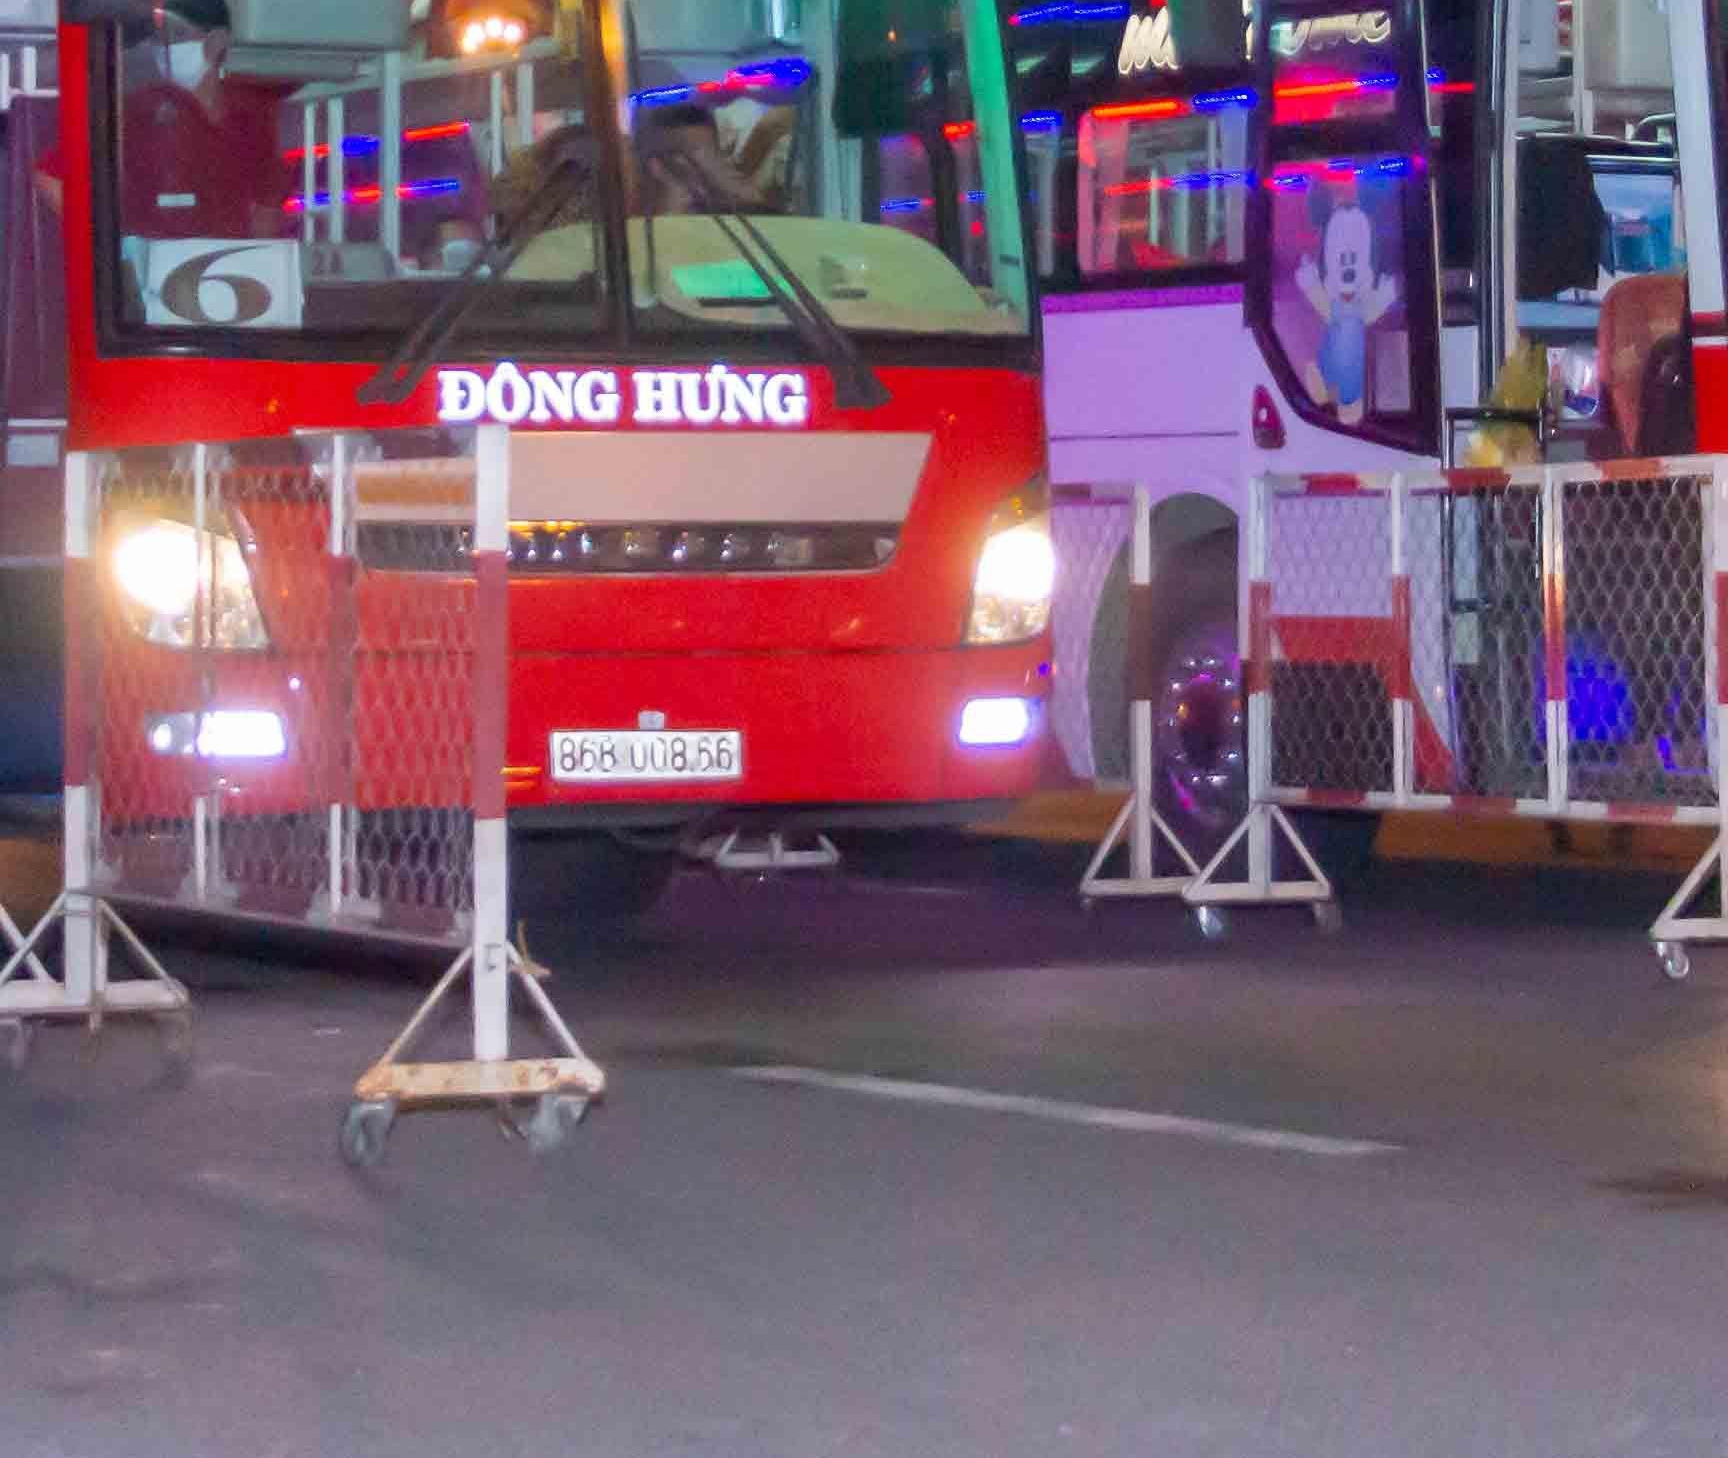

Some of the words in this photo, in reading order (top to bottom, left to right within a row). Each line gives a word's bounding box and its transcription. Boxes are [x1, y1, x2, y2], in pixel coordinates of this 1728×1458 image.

[160, 244, 273, 324] 6
[437, 362, 621, 423] ĐÔNG
[633, 364, 808, 423] HƯNG
